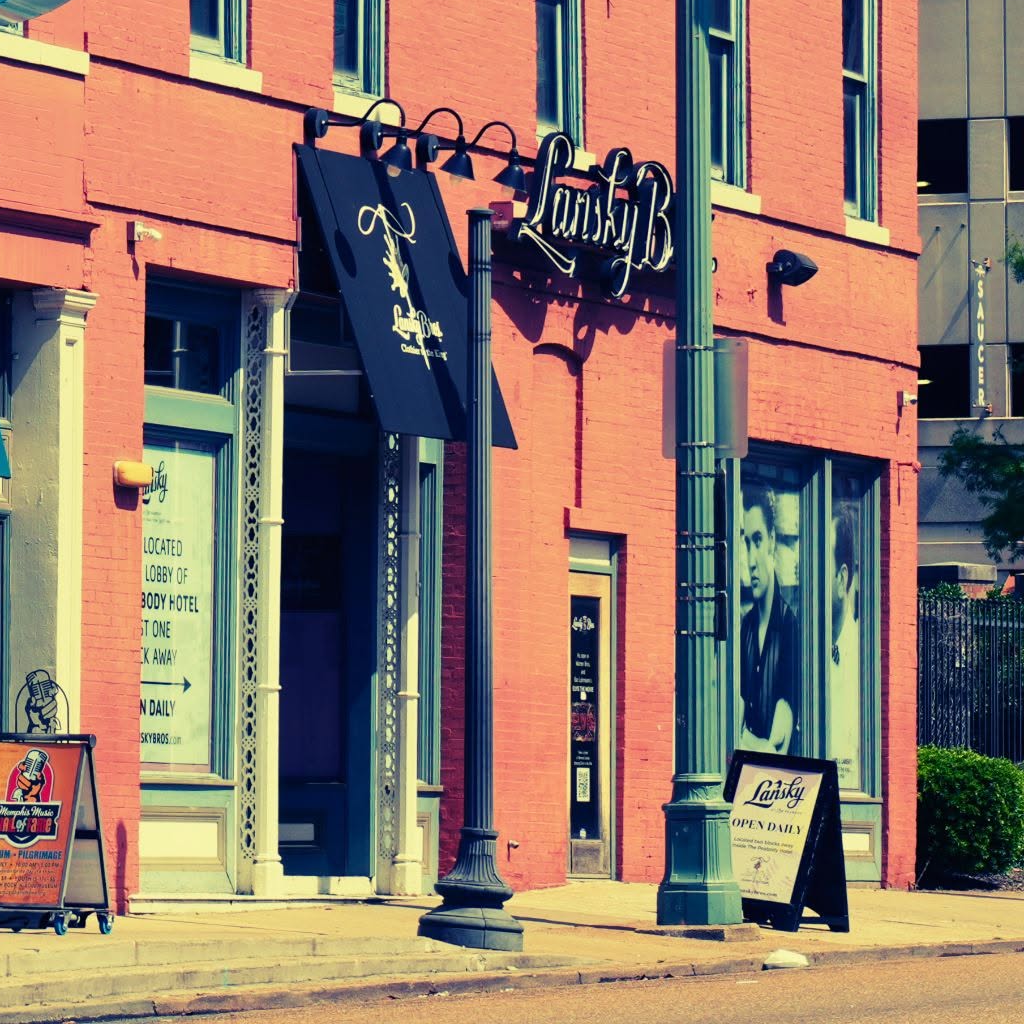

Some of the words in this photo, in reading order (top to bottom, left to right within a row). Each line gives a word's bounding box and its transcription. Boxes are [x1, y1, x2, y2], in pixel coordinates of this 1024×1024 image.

[517, 132, 638, 299] Lansky
[976, 279, 985, 407] SAUCER
[143, 536, 183, 557] LOCATED
[145, 564, 174, 584] LOBBY
[176, 567, 188, 585] OF
[141, 591, 167, 611] BODY
[169, 593, 199, 613] HOTEL
[152, 619, 171, 639] ONE
[152, 647, 178, 666] AWAY
[149, 699, 176, 717] DAILY
[140, 731, 182, 746] SKYBROS.com
[743, 776, 805, 809] Lansky
[31, 805, 54, 817] Music
[16, 817, 28, 833] of
[731, 818, 764, 830] OPEN
[767, 822, 801, 835] DAILY
[18, 849, 63, 861] PILGRIMAGE
